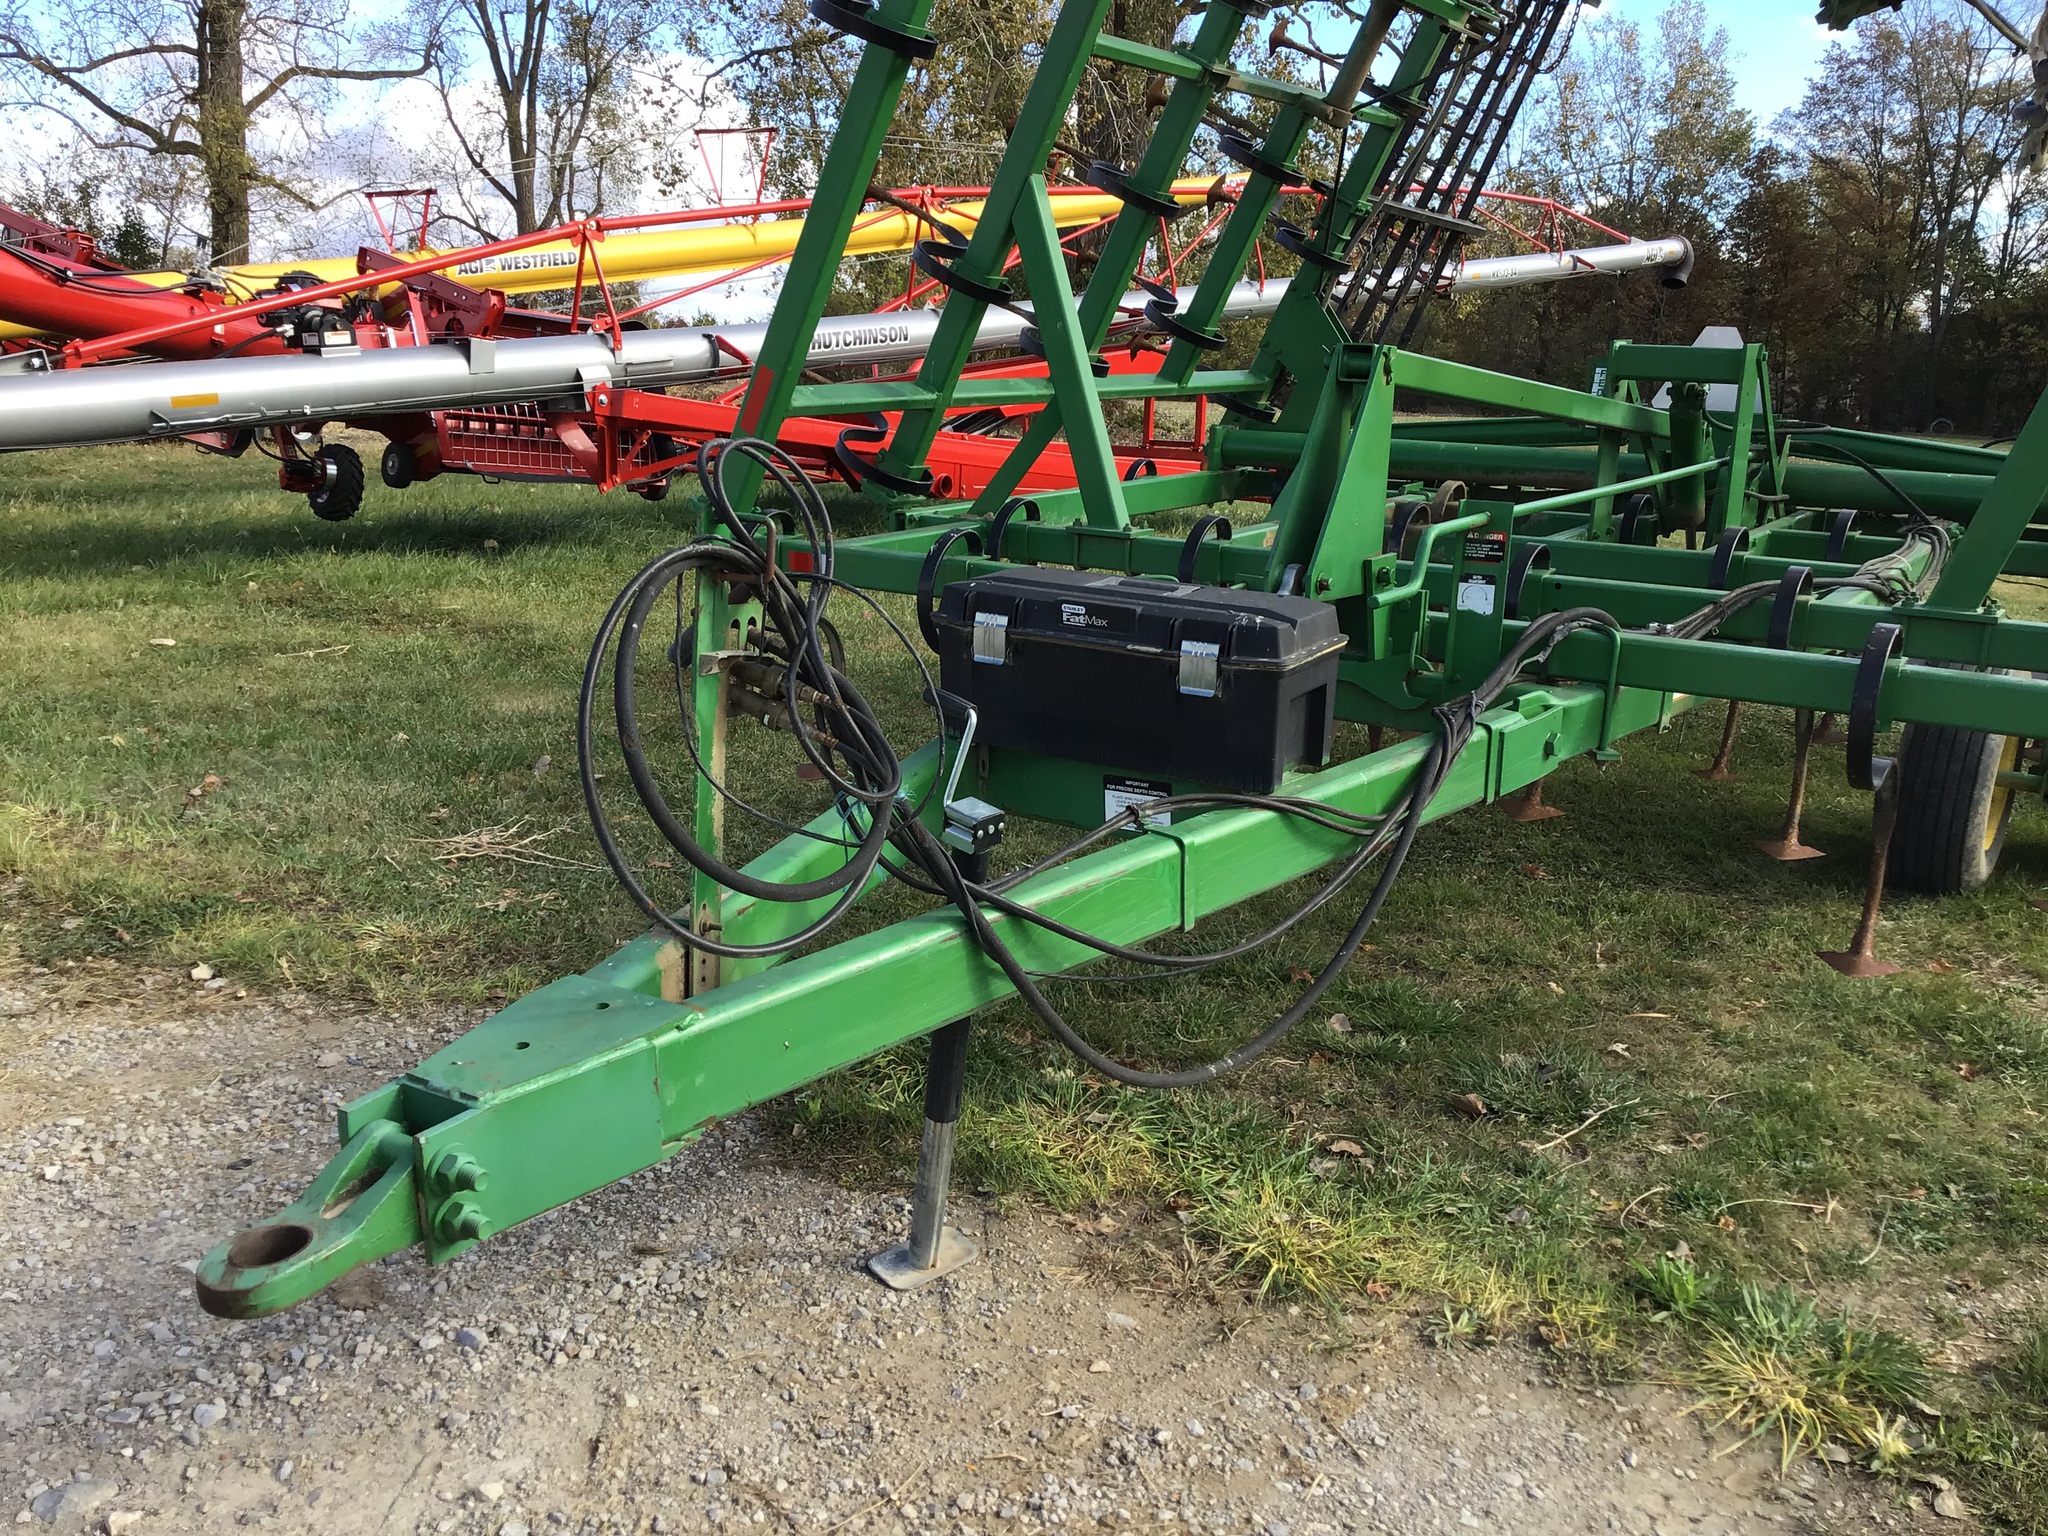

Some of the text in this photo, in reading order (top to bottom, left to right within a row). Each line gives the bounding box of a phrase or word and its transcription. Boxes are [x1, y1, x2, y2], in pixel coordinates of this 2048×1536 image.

[458, 252, 577, 275] AGI WESTFIELD
[811, 326, 909, 350] HUTCHINSON
[1063, 612, 1108, 627] FatMax
